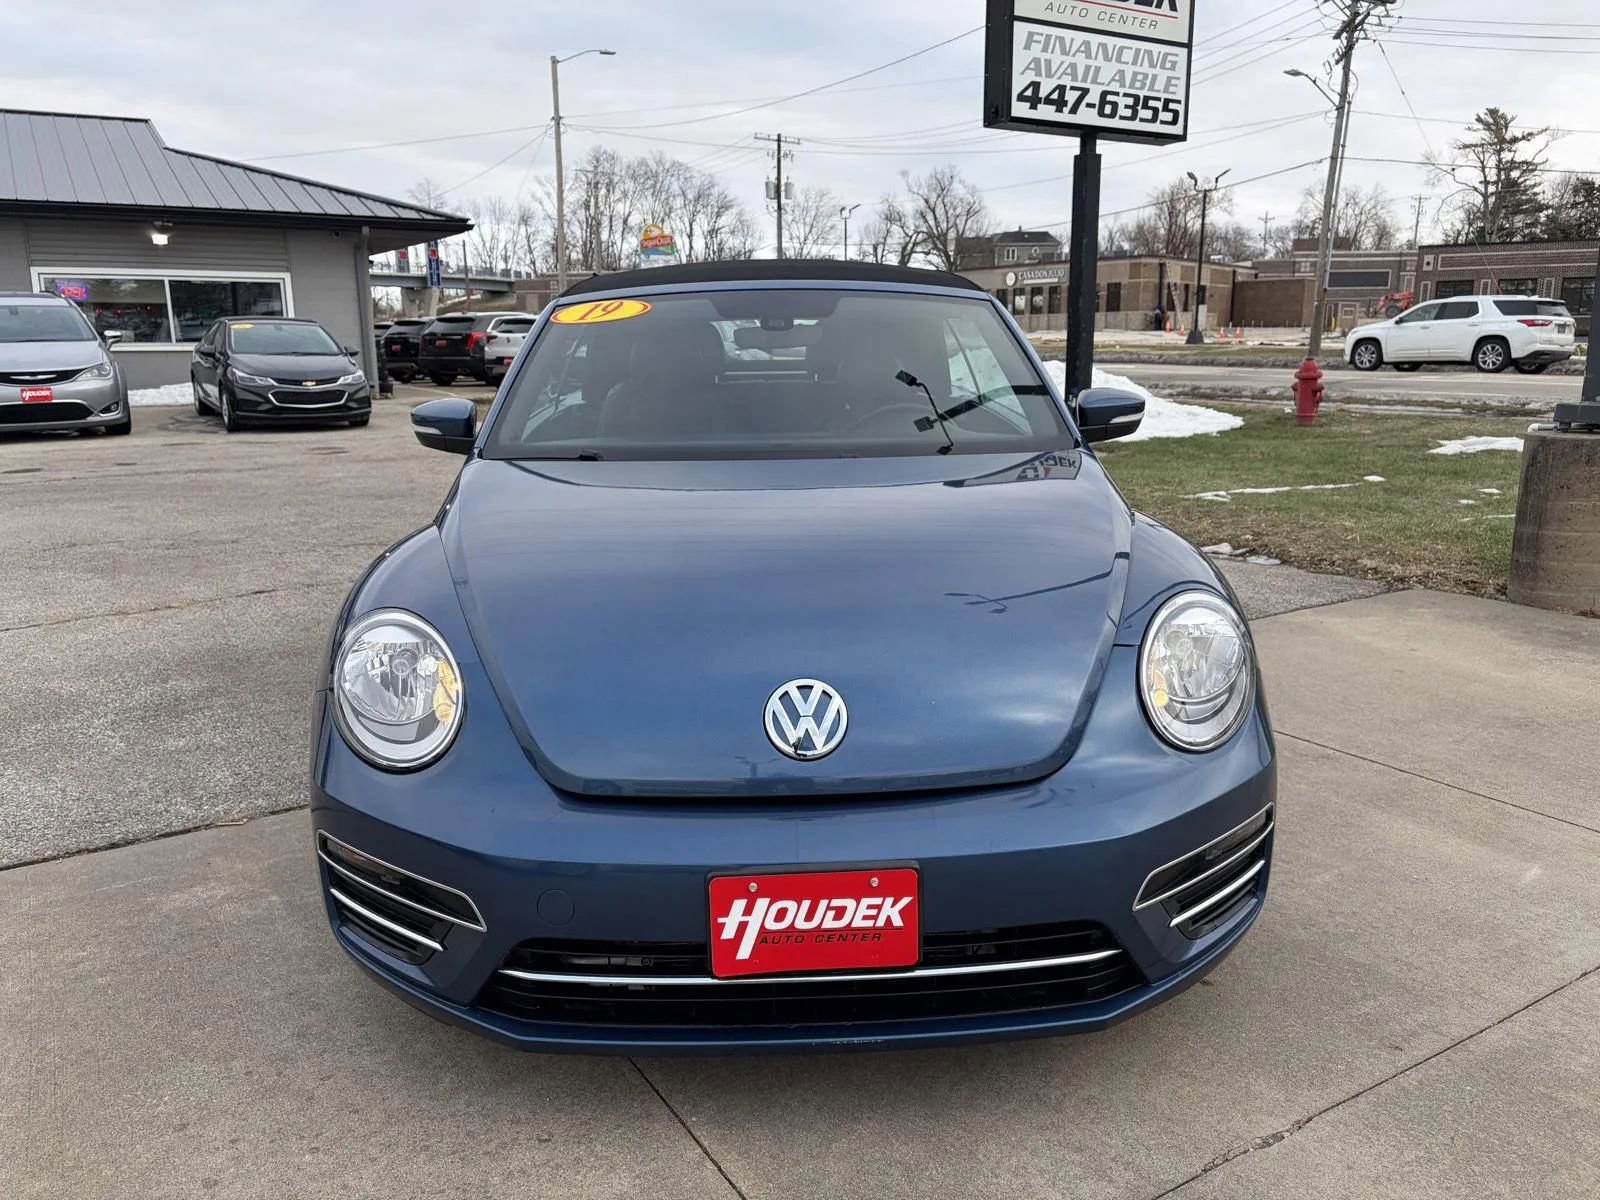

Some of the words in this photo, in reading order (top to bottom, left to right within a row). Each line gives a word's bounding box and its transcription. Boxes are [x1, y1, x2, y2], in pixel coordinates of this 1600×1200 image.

[1045, 2, 1089, 18] AUTO
[1097, 10, 1159, 30] CENTER
[1023, 31, 1179, 72] FINANCING
[1020, 57, 1180, 95] AVAILABLE
[1016, 80, 1182, 126] 447-6355
[1018, 270, 1035, 280] CASA
[574, 301, 624, 320] 19
[717, 896, 914, 960] HOUDEK
[759, 934, 805, 945] AUTO
[814, 932, 882, 944] CENTER
